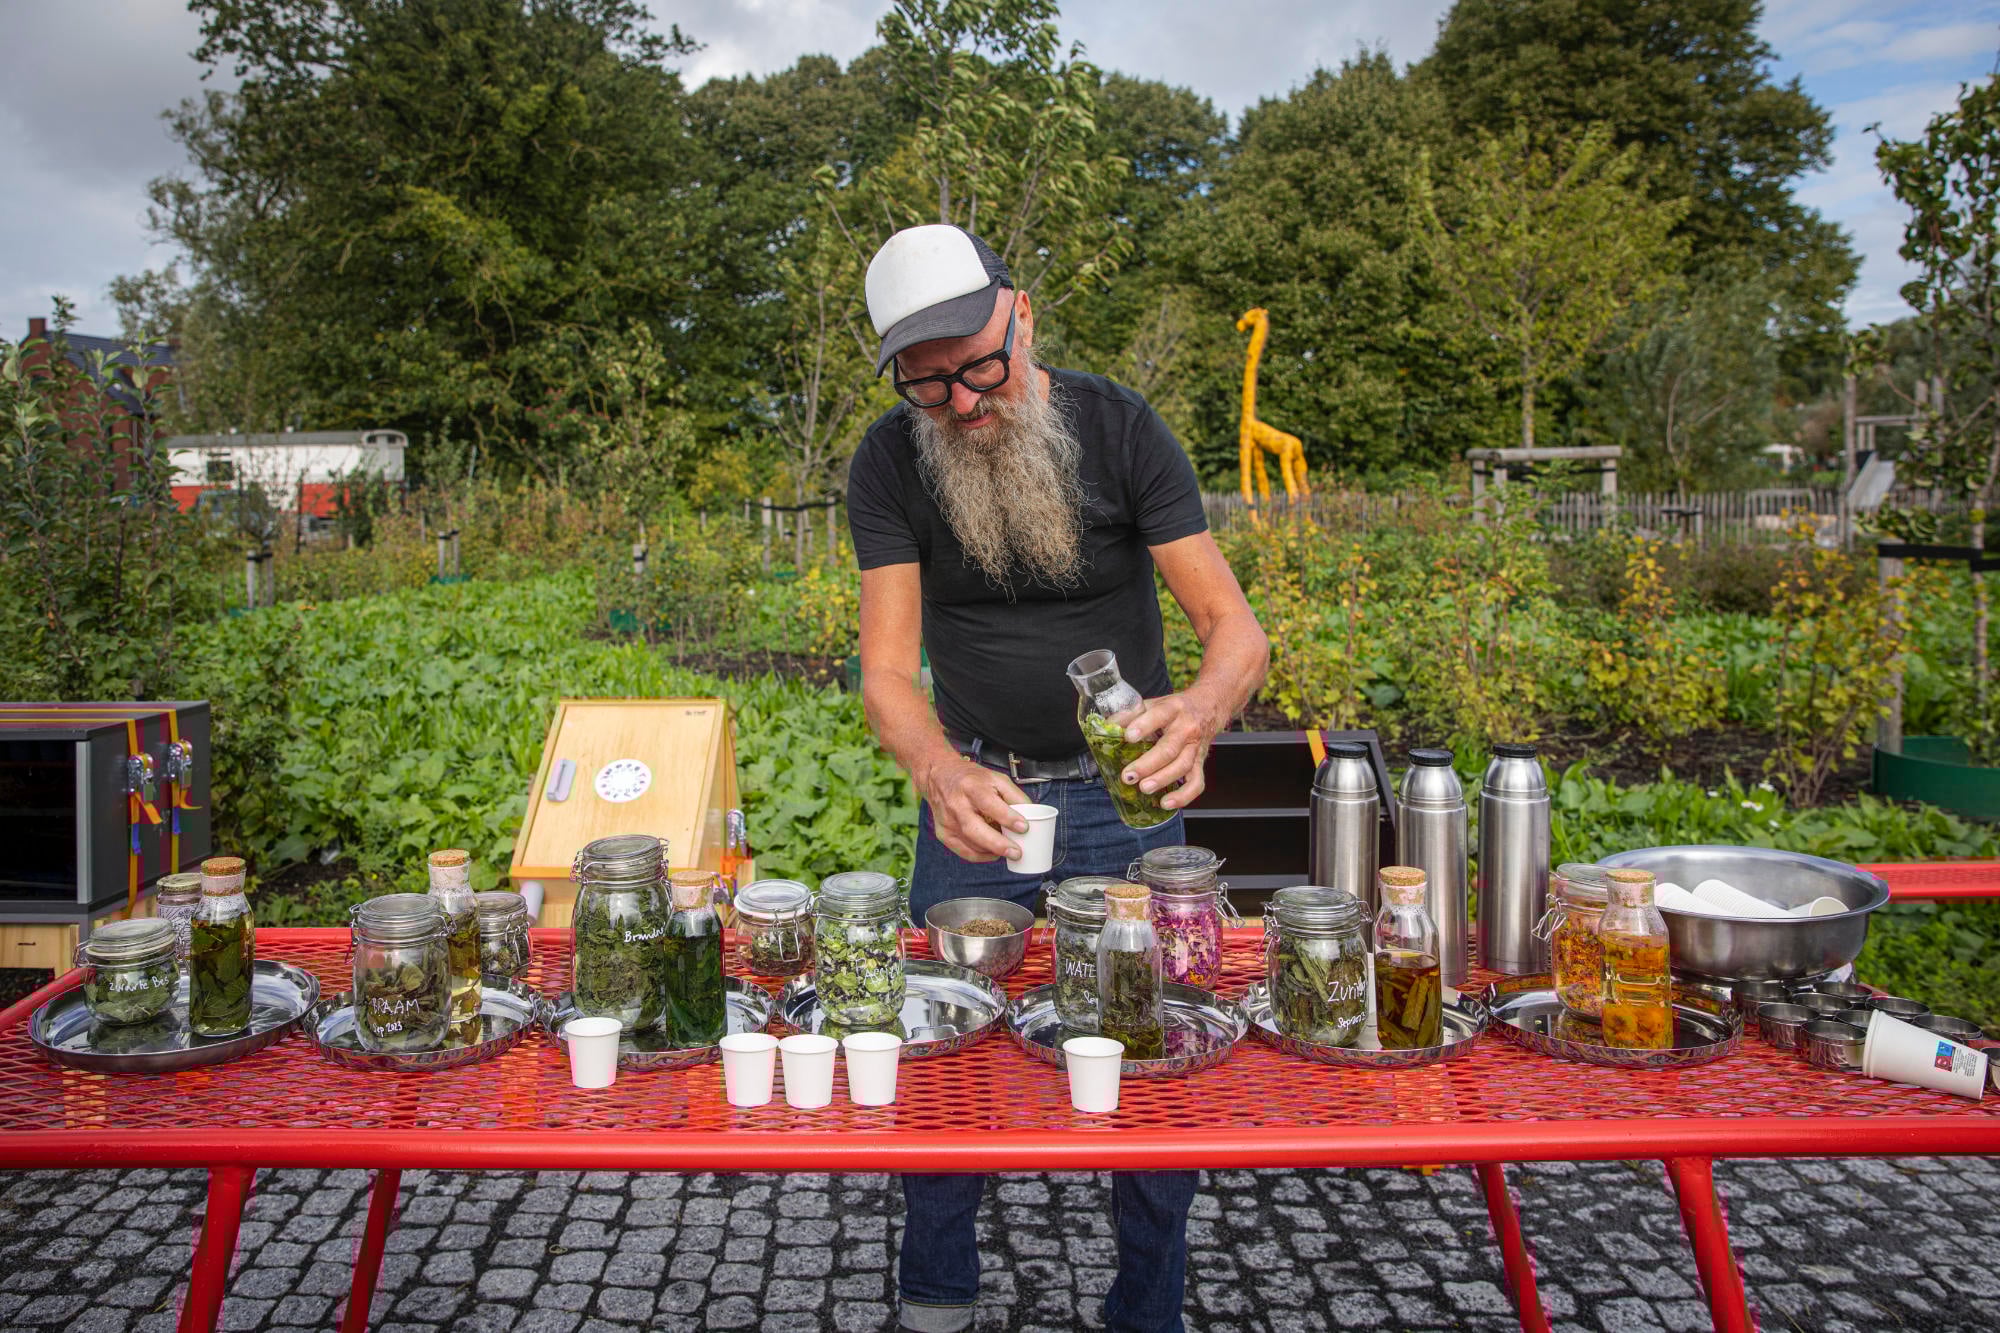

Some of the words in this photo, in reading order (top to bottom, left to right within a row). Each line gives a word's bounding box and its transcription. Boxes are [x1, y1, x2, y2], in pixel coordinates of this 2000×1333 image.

[1065, 958, 1097, 978] WATE
[151, 975, 169, 988] Bes
[385, 1020, 403, 1033] 2023
